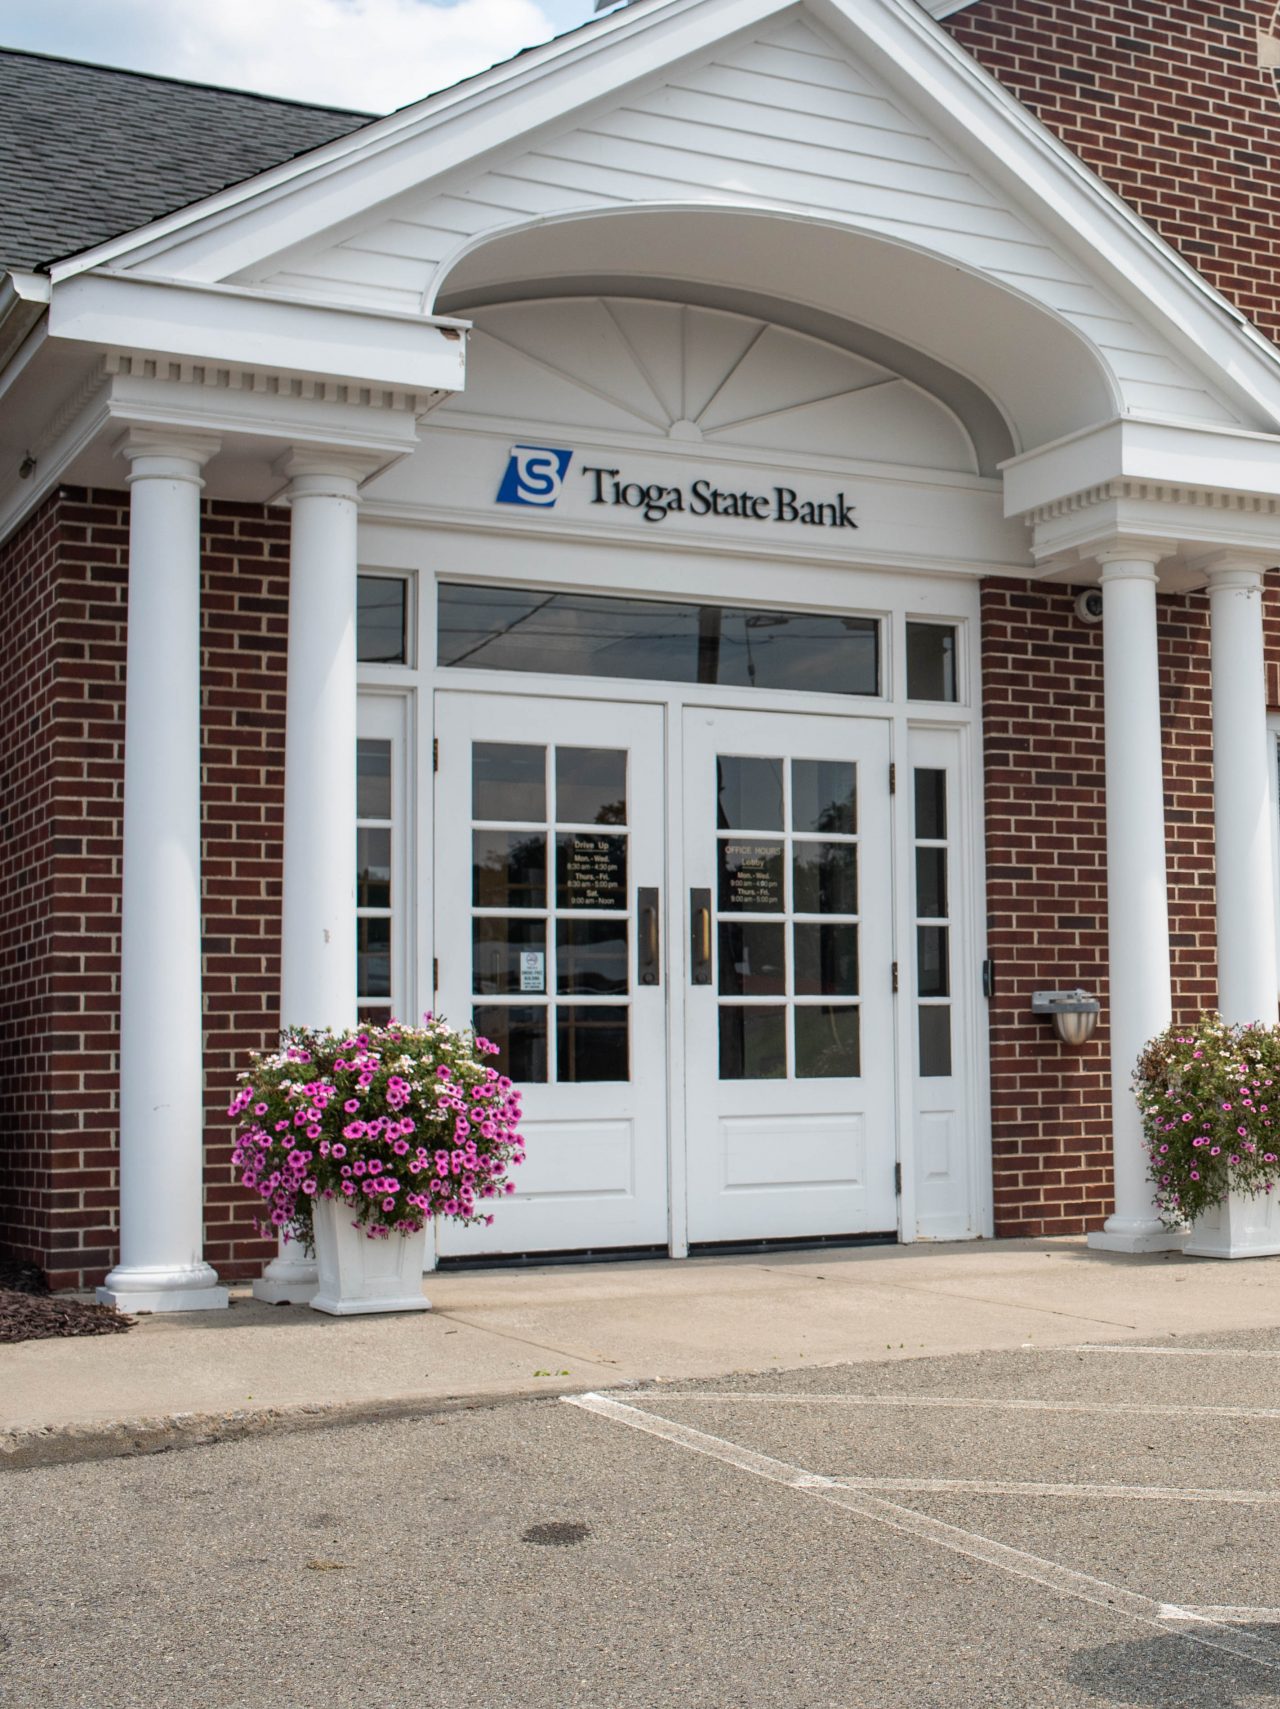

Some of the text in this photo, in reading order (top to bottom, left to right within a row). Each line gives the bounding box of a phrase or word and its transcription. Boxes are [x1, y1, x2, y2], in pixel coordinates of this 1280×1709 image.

[582, 466, 859, 529] Tioga State Bank
[574, 840, 609, 850] Drive Up
[724, 846, 781, 855] OFFICE HOURS
[742, 859, 765, 867] Lobby
